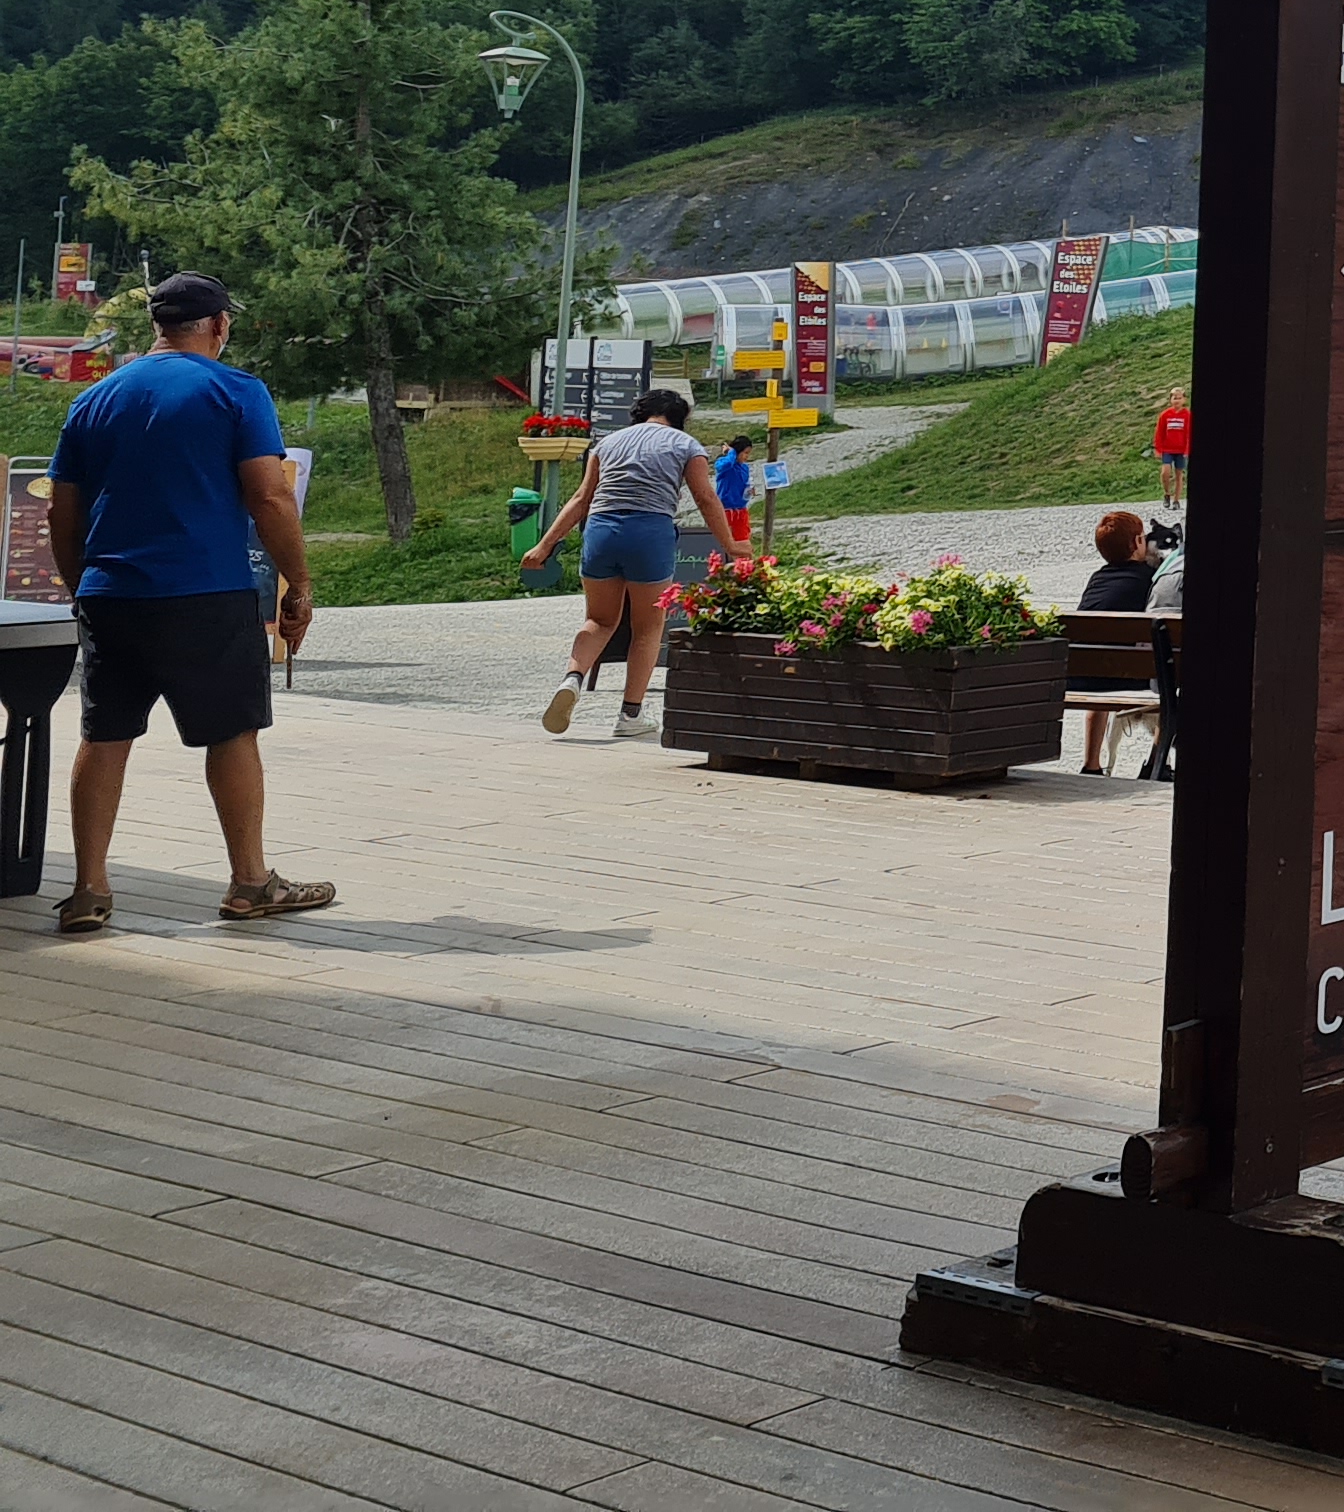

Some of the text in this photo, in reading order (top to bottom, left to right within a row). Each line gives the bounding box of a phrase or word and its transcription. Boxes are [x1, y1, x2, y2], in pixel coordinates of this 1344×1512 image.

[1057, 252, 1093, 266] Espace
[1060, 269, 1075, 279] des
[1052, 280, 1088, 293] Etoiles
